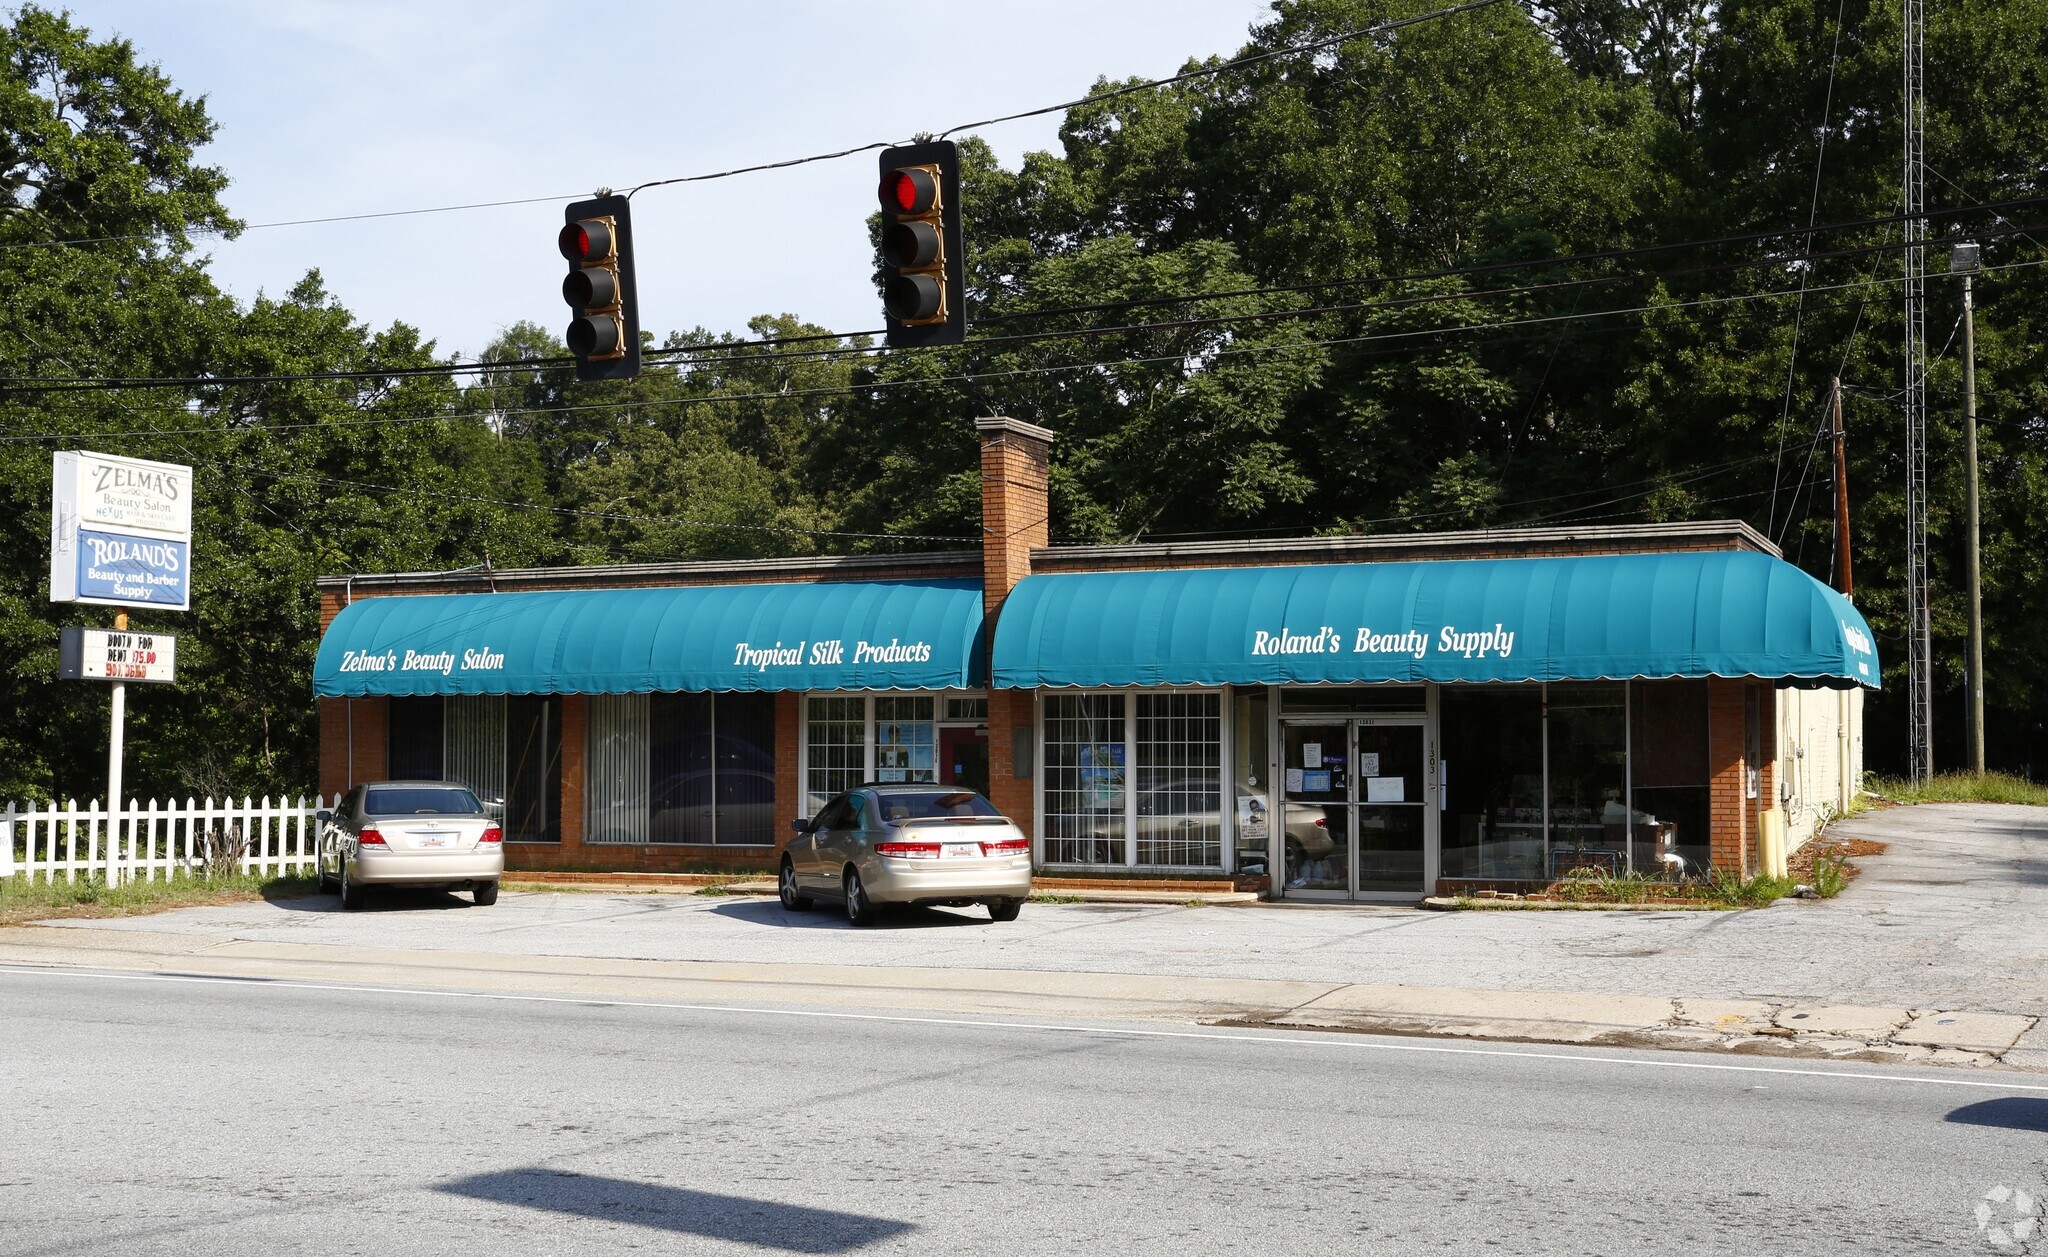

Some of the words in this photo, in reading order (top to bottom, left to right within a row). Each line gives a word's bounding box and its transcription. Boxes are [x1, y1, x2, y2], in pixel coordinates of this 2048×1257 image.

[92, 465, 178, 501] ZELMA'S
[103, 493, 140, 511] Beauty
[143, 498, 171, 513] Salon
[87, 538, 179, 572] ROLAND'S
[88, 567, 125, 584] Beauty
[125, 572, 144, 583] and
[146, 573, 179, 586] Barber
[113, 584, 153, 599] Supply
[107, 634, 132, 648] BOOTH
[138, 636, 153, 649] FOR
[1252, 627, 1341, 656] Roland's
[1353, 628, 1429, 660] Beauty
[1437, 623, 1515, 660] Supply
[107, 649, 127, 662] RENT
[339, 650, 397, 672] Zelma's
[401, 650, 455, 676] Beauty
[460, 648, 505, 671] Salon
[734, 643, 801, 673] Tropical
[808, 641, 844, 663] Silk
[852, 639, 931, 664] Products
